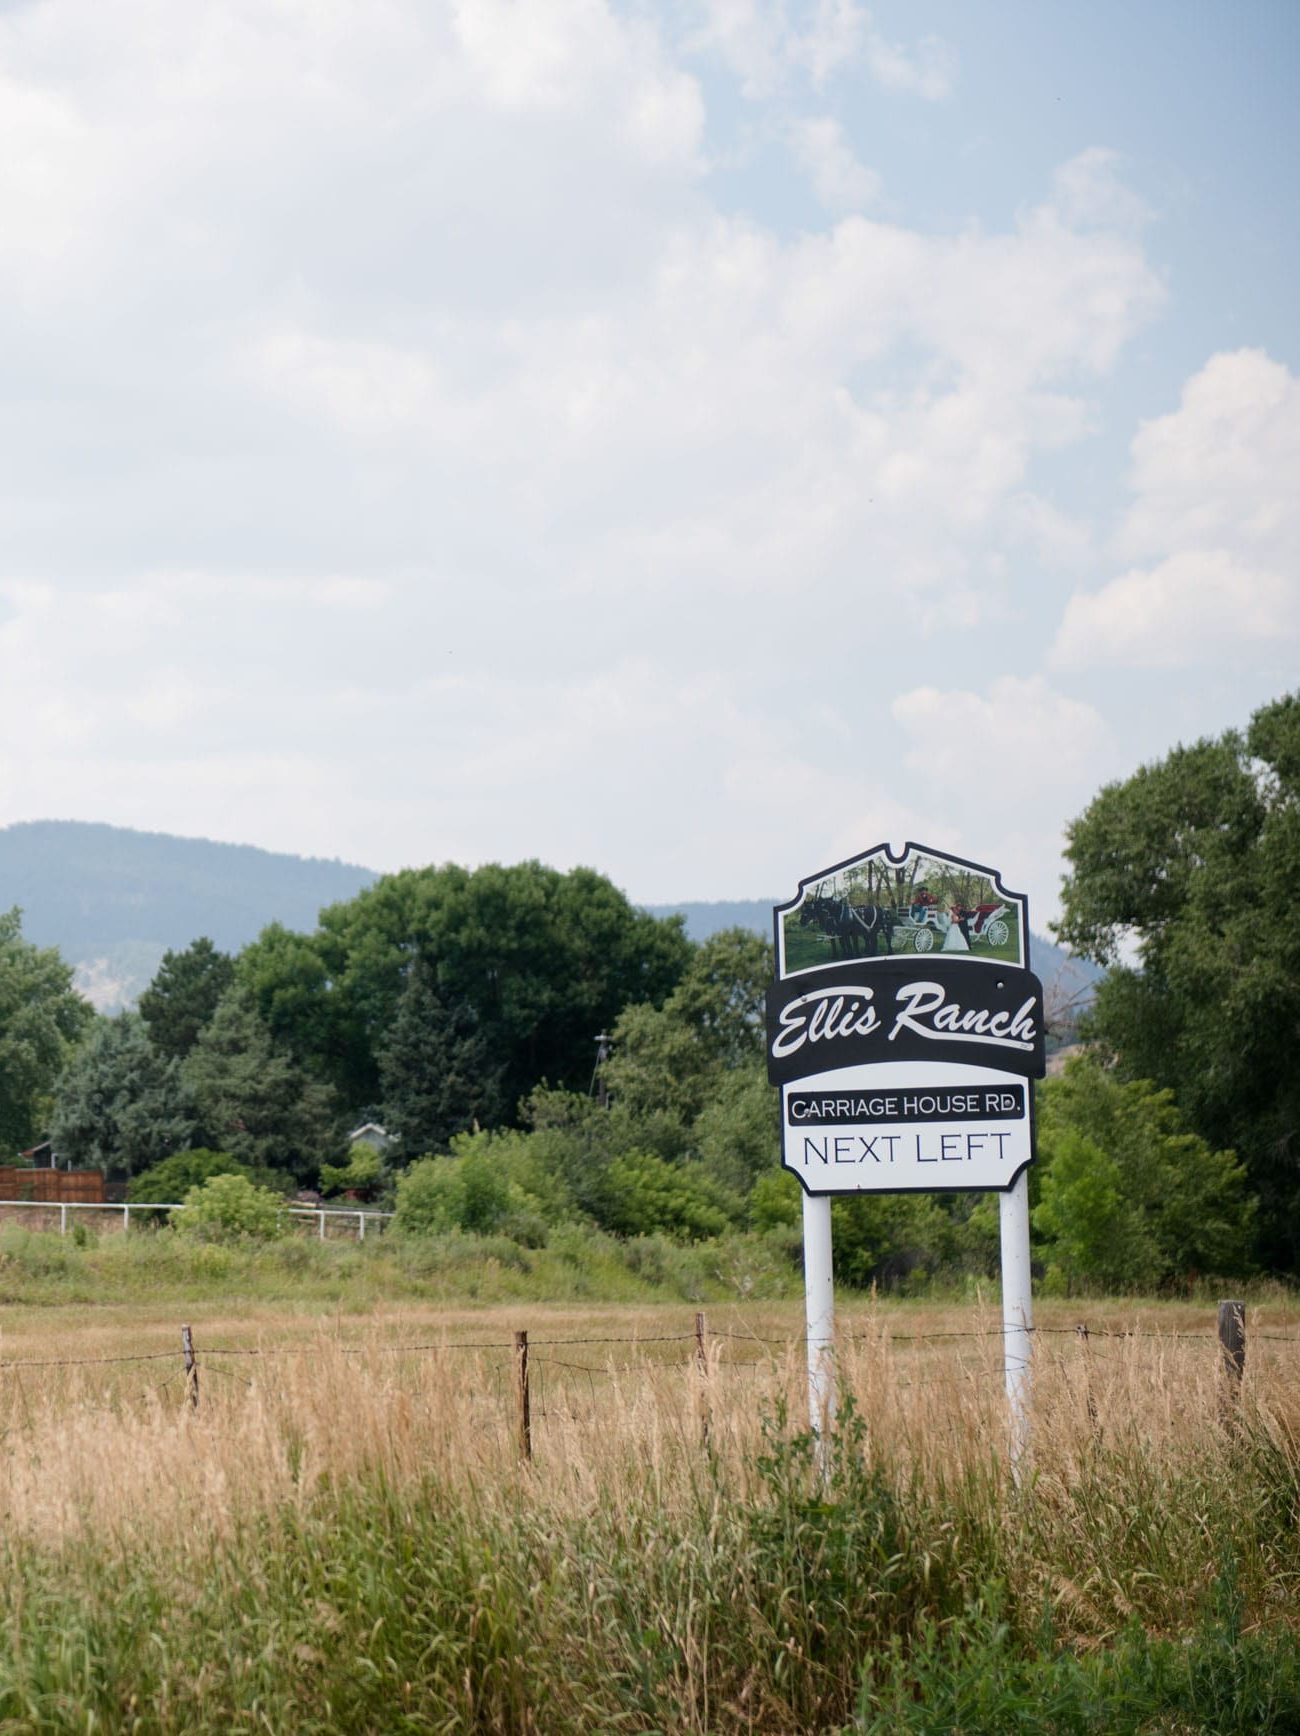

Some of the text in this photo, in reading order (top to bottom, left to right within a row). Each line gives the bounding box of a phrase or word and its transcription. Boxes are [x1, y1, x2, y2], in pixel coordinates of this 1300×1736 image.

[772, 982, 1036, 1058] Ellis Ranch
[791, 1094, 1021, 1118] CARRIAGE HOUSE RD.
[803, 1133, 1011, 1165] NEXT LEFT
